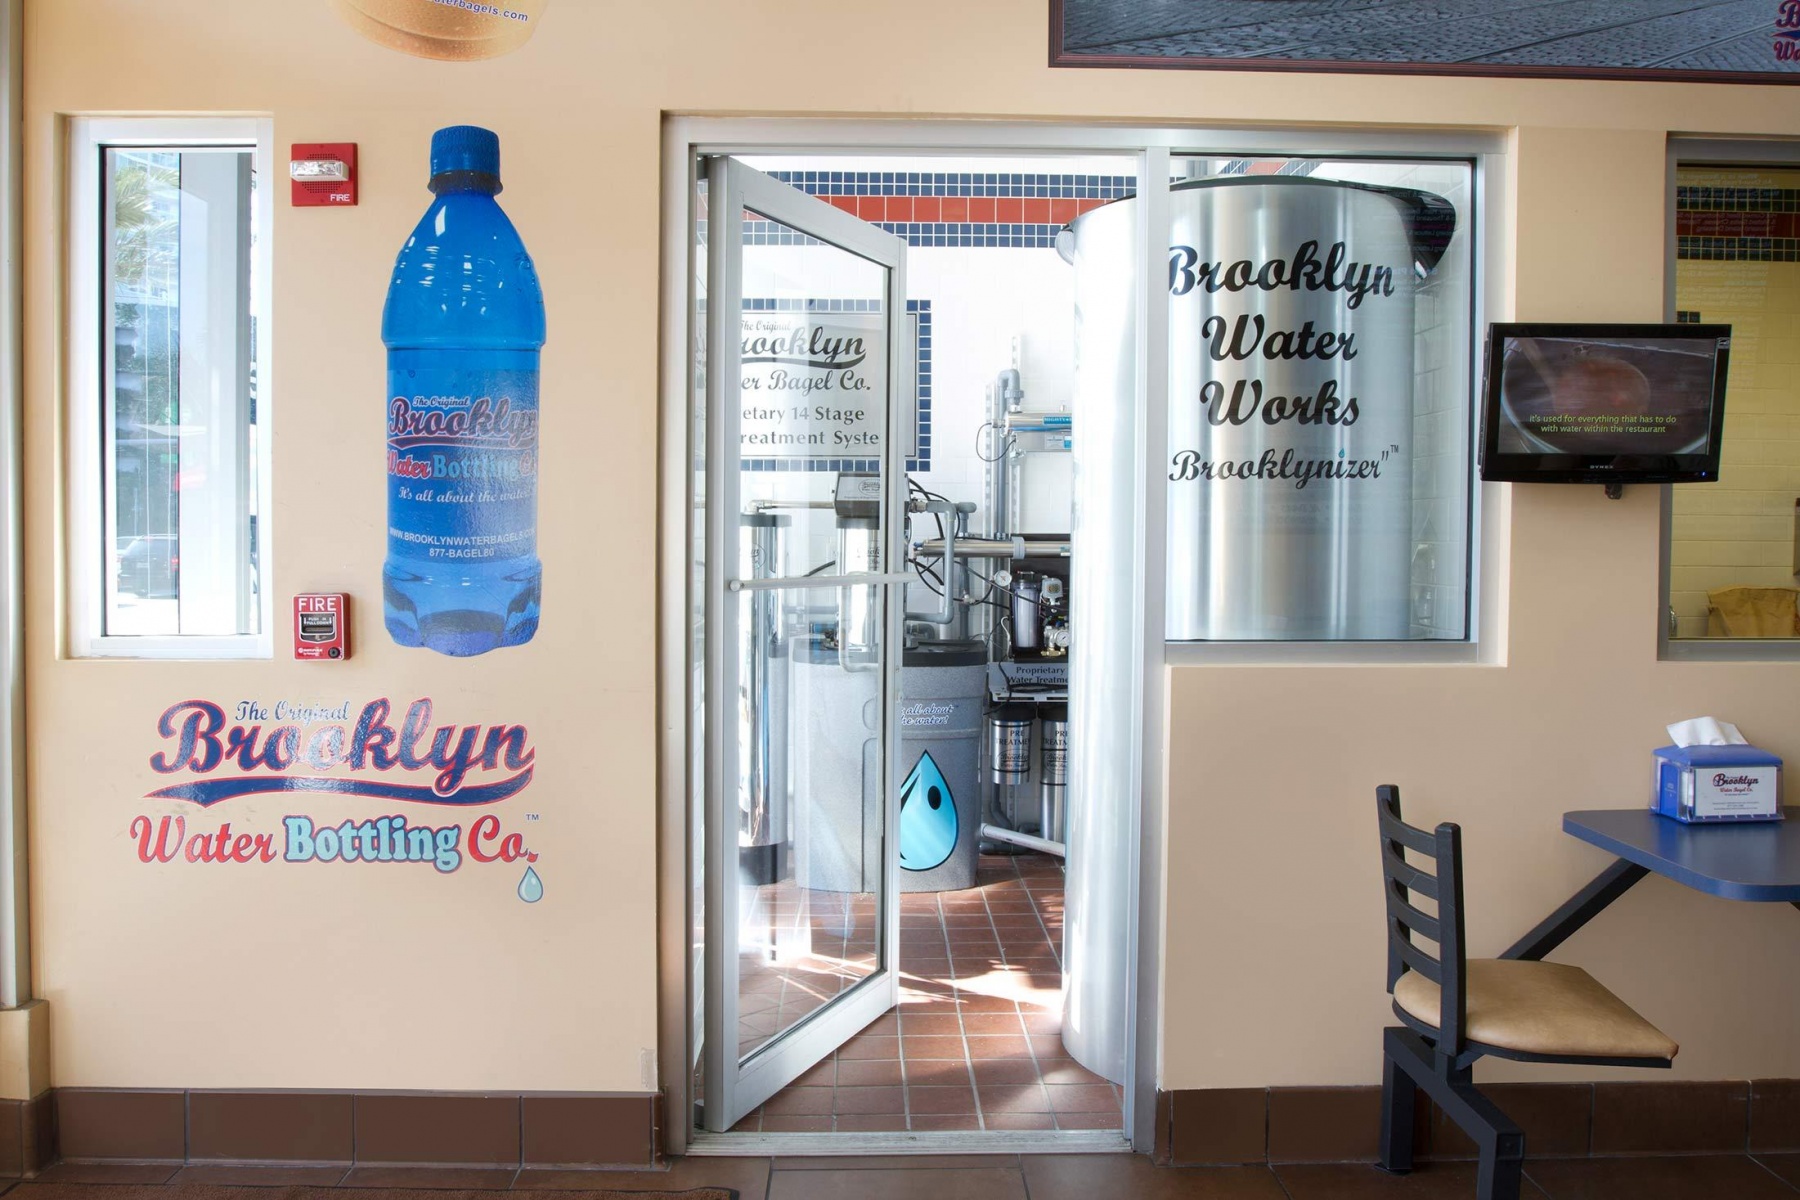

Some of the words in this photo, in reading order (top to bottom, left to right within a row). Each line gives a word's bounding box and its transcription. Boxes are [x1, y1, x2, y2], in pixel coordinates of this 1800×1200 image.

[434, 0, 528, 21] erbagels.com
[330, 194, 350, 202] FIRE
[1169, 240, 1395, 310] Brooklyn
[755, 320, 792, 334] Original
[1201, 314, 1357, 361] Water
[741, 376, 762, 390] er
[767, 369, 834, 397] Bagel
[839, 370, 871, 391] Co.
[412, 396, 428, 407] The
[429, 396, 470, 409] Original
[1199, 379, 1360, 426] Works
[743, 407, 786, 424] etary
[791, 407, 810, 420] 14
[815, 406, 865, 426] Stage
[1543, 415, 1562, 423] used
[1564, 415, 1577, 423] for
[1578, 415, 1619, 424] everything
[1622, 415, 1638, 423] that
[1639, 415, 1654, 423] has
[1665, 415, 1677, 423] do
[1541, 425, 1559, 433] with
[1584, 425, 1609, 433] within
[1610, 425, 1623, 433] the
[741, 432, 825, 445] reatment
[833, 430, 880, 450] Syste
[399, 487, 413, 500] It's
[415, 490, 434, 502] all
[436, 491, 474, 503] about
[477, 490, 497, 503] the
[429, 548, 495, 558] 877-BAGEL80
[298, 598, 337, 611] FIRE
[1016, 666, 1066, 676] Proprietary
[1009, 676, 1033, 684] Water
[234, 700, 269, 721] The
[274, 700, 351, 725] Original
[922, 702, 954, 715] about
[901, 714, 914, 725] he
[148, 696, 536, 797] Brooklyn
[1712, 773, 1759, 787] Brooklyn
[130, 815, 277, 863] Water
[282, 814, 464, 874] Bottling
[467, 815, 540, 863] Co.
